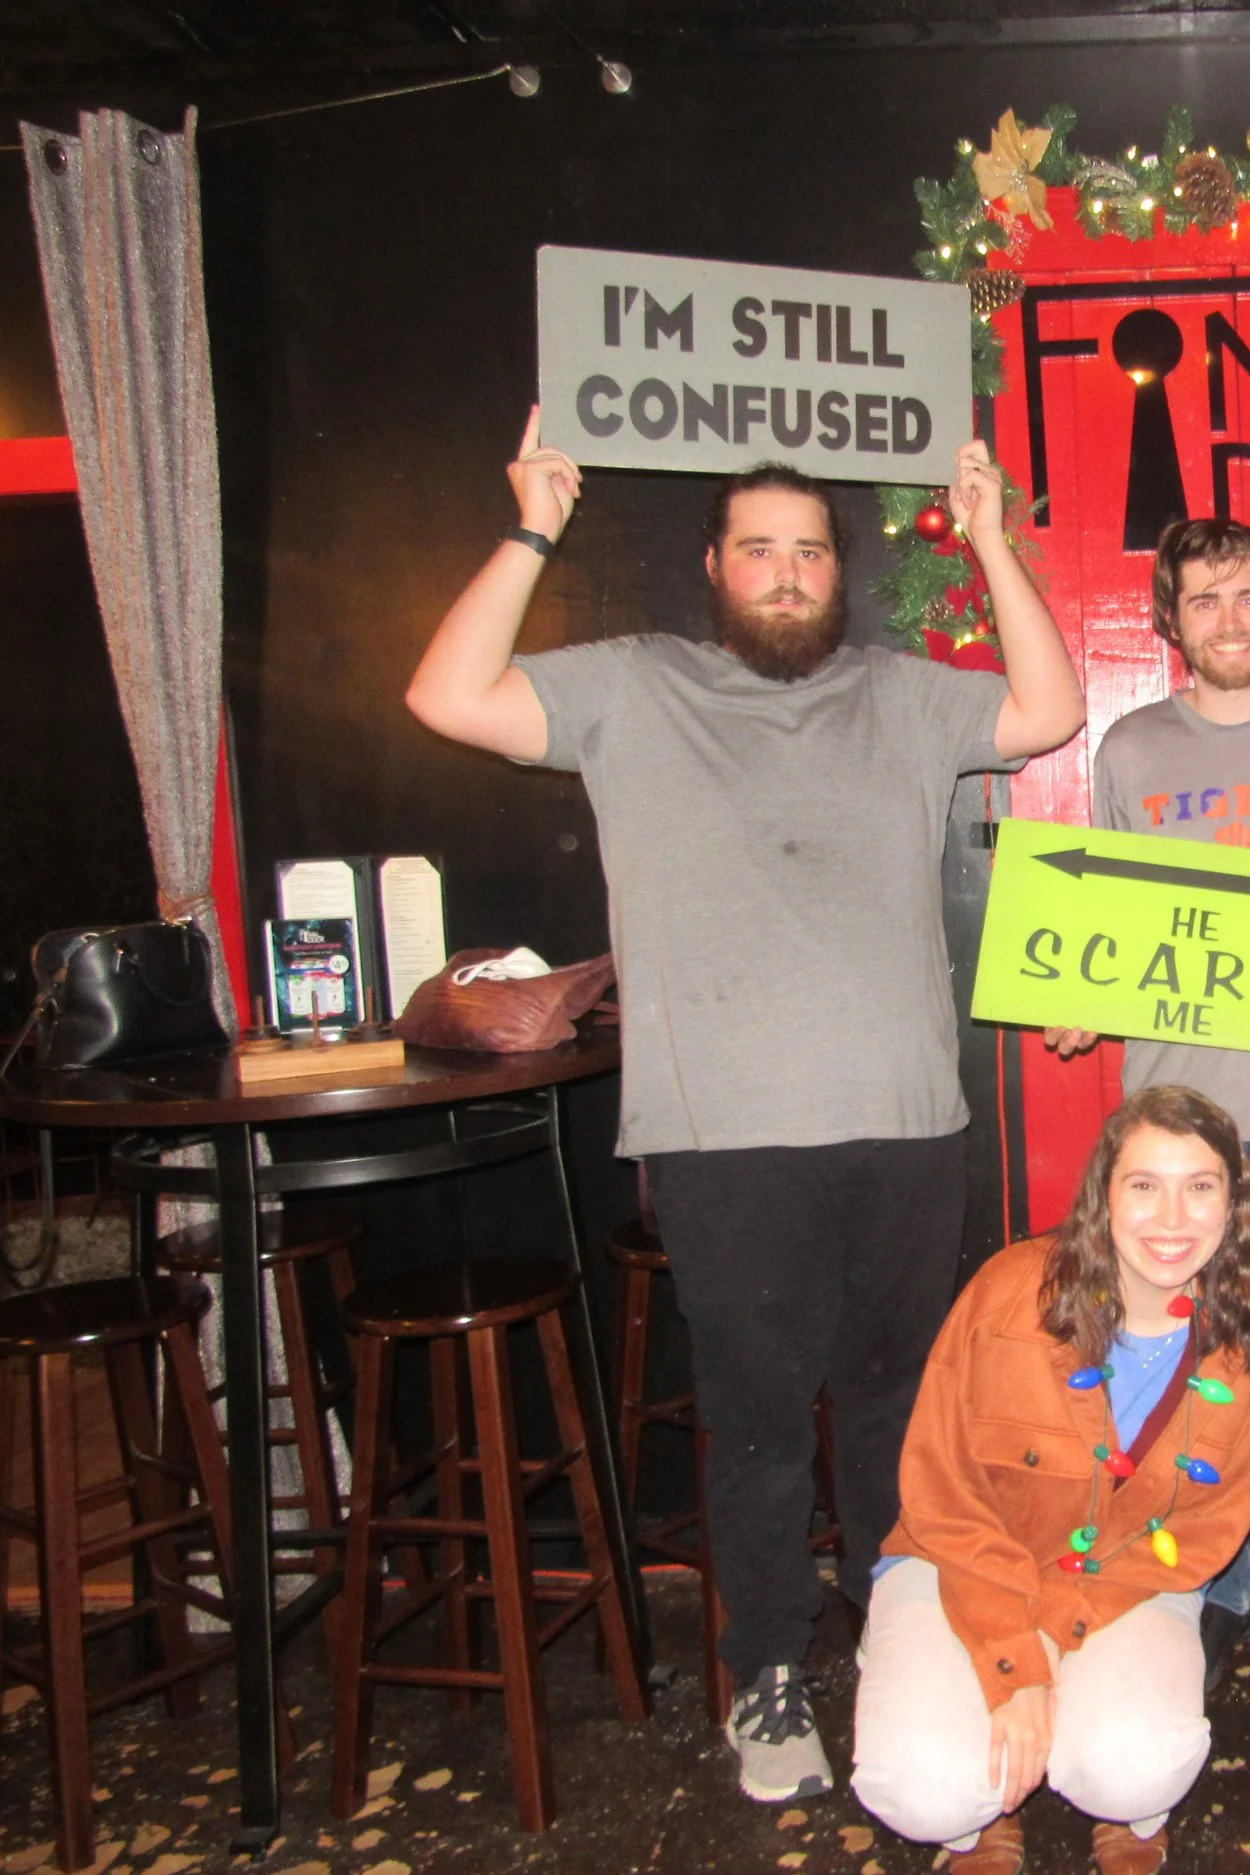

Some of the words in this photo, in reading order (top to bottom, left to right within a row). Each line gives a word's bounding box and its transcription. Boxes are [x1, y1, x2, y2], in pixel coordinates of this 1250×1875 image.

[603, 285, 694, 352] I'M
[732, 297, 905, 368] STILL
[576, 374, 932, 455] CONFUSED
[1171, 907, 1221, 942] HE
[1153, 1000, 1215, 1036] ME
